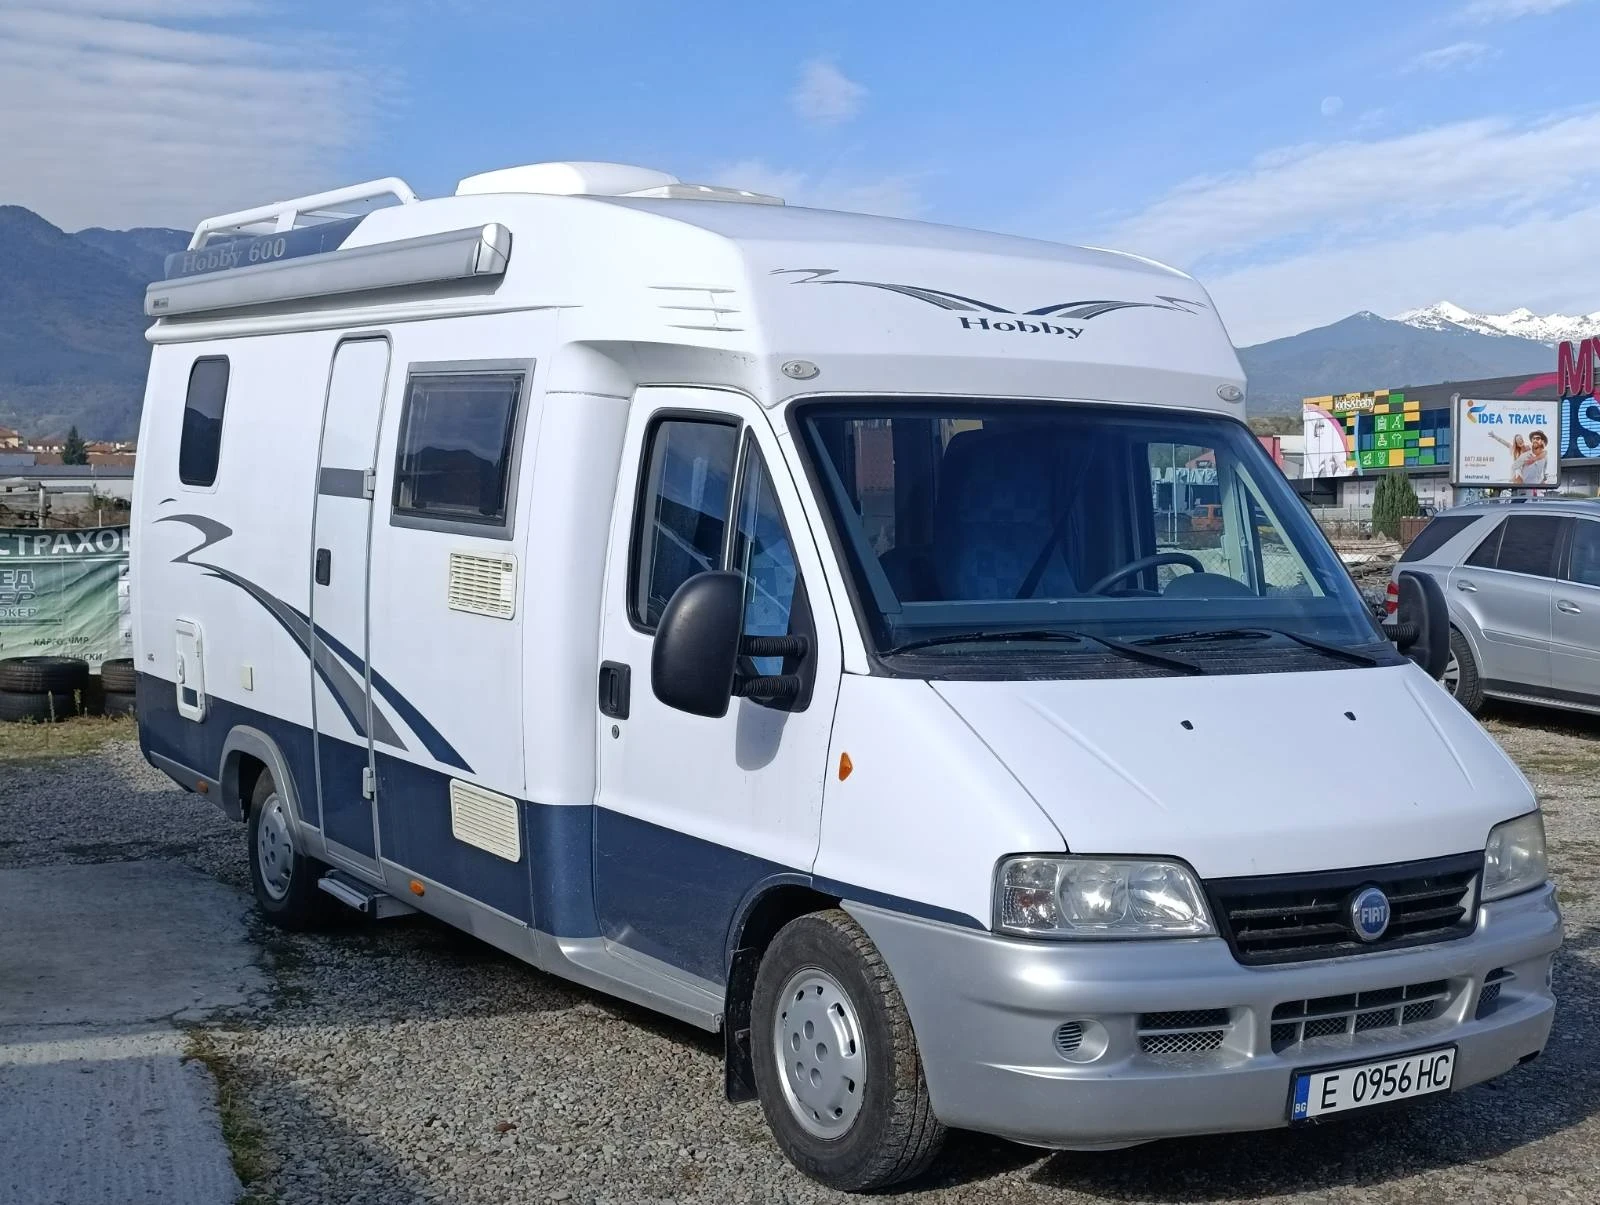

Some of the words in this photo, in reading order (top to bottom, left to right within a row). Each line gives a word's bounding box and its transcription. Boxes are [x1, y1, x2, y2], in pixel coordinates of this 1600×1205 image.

[182, 249, 243, 273] Hobby
[249, 237, 286, 262] 600
[957, 317, 1084, 340] Hobby
[1478, 413, 1503, 425] IDEA
[1508, 413, 1548, 425] TRAVEL
[1361, 905, 1386, 924] FIAT
[1320, 1075, 1340, 1110] E
[1352, 1062, 1411, 1103] 0956
[1416, 1054, 1449, 1091] HC
[1294, 1102, 1307, 1113] BG
